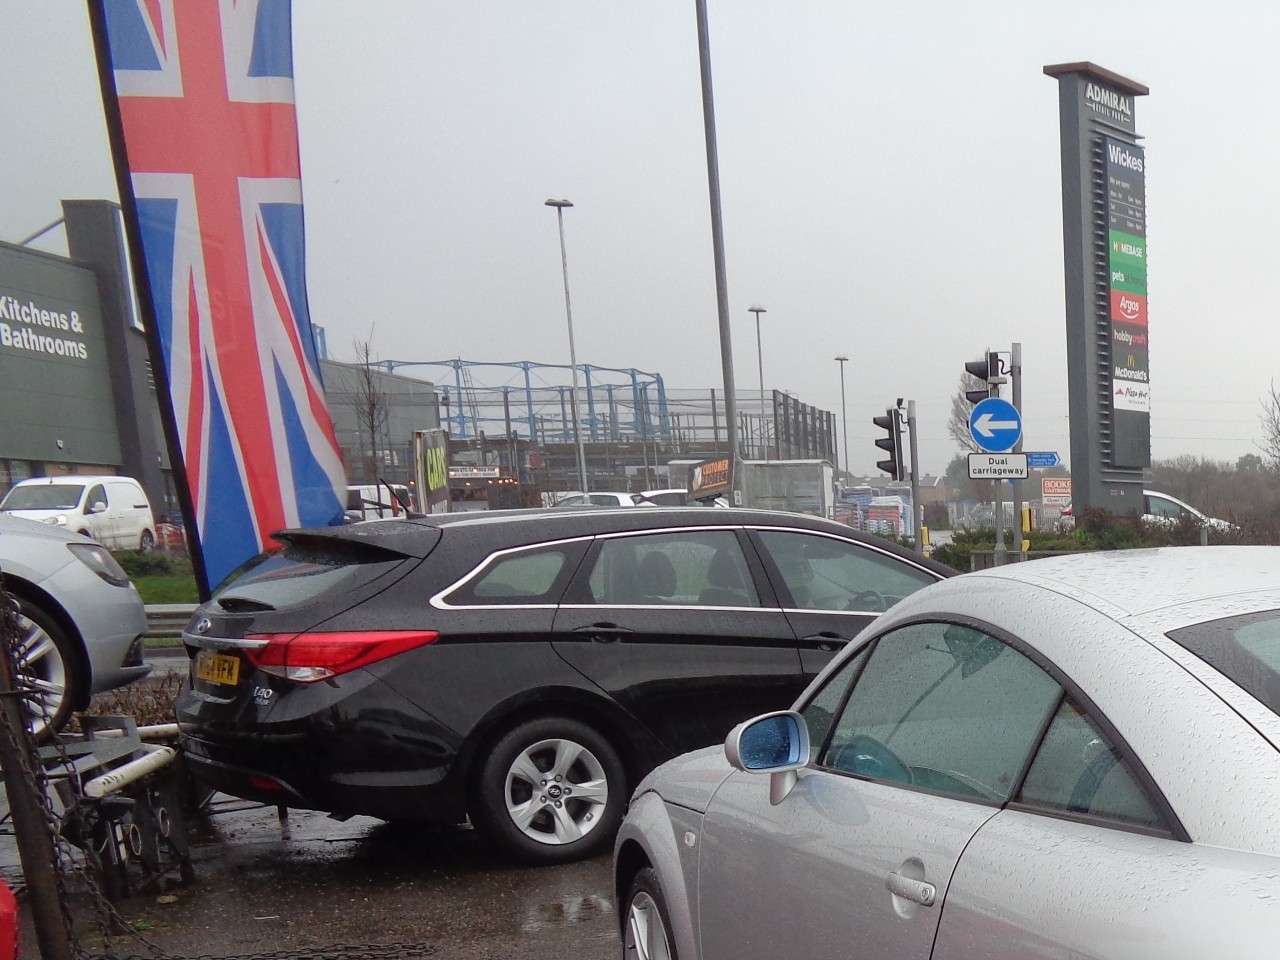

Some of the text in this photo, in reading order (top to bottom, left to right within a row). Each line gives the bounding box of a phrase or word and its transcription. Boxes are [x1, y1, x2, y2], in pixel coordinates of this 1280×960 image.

[1086, 83, 1131, 115] ADMIRAL
[1108, 144, 1143, 172] Wickes
[1113, 241, 1143, 257] HOMEBASE
[0, 295, 83, 333] Kitchens &
[1120, 296, 1139, 313] Argos
[0, 323, 88, 359] Bathrooms
[972, 467, 1024, 475] carriageway
[988, 457, 1008, 465] Dual
